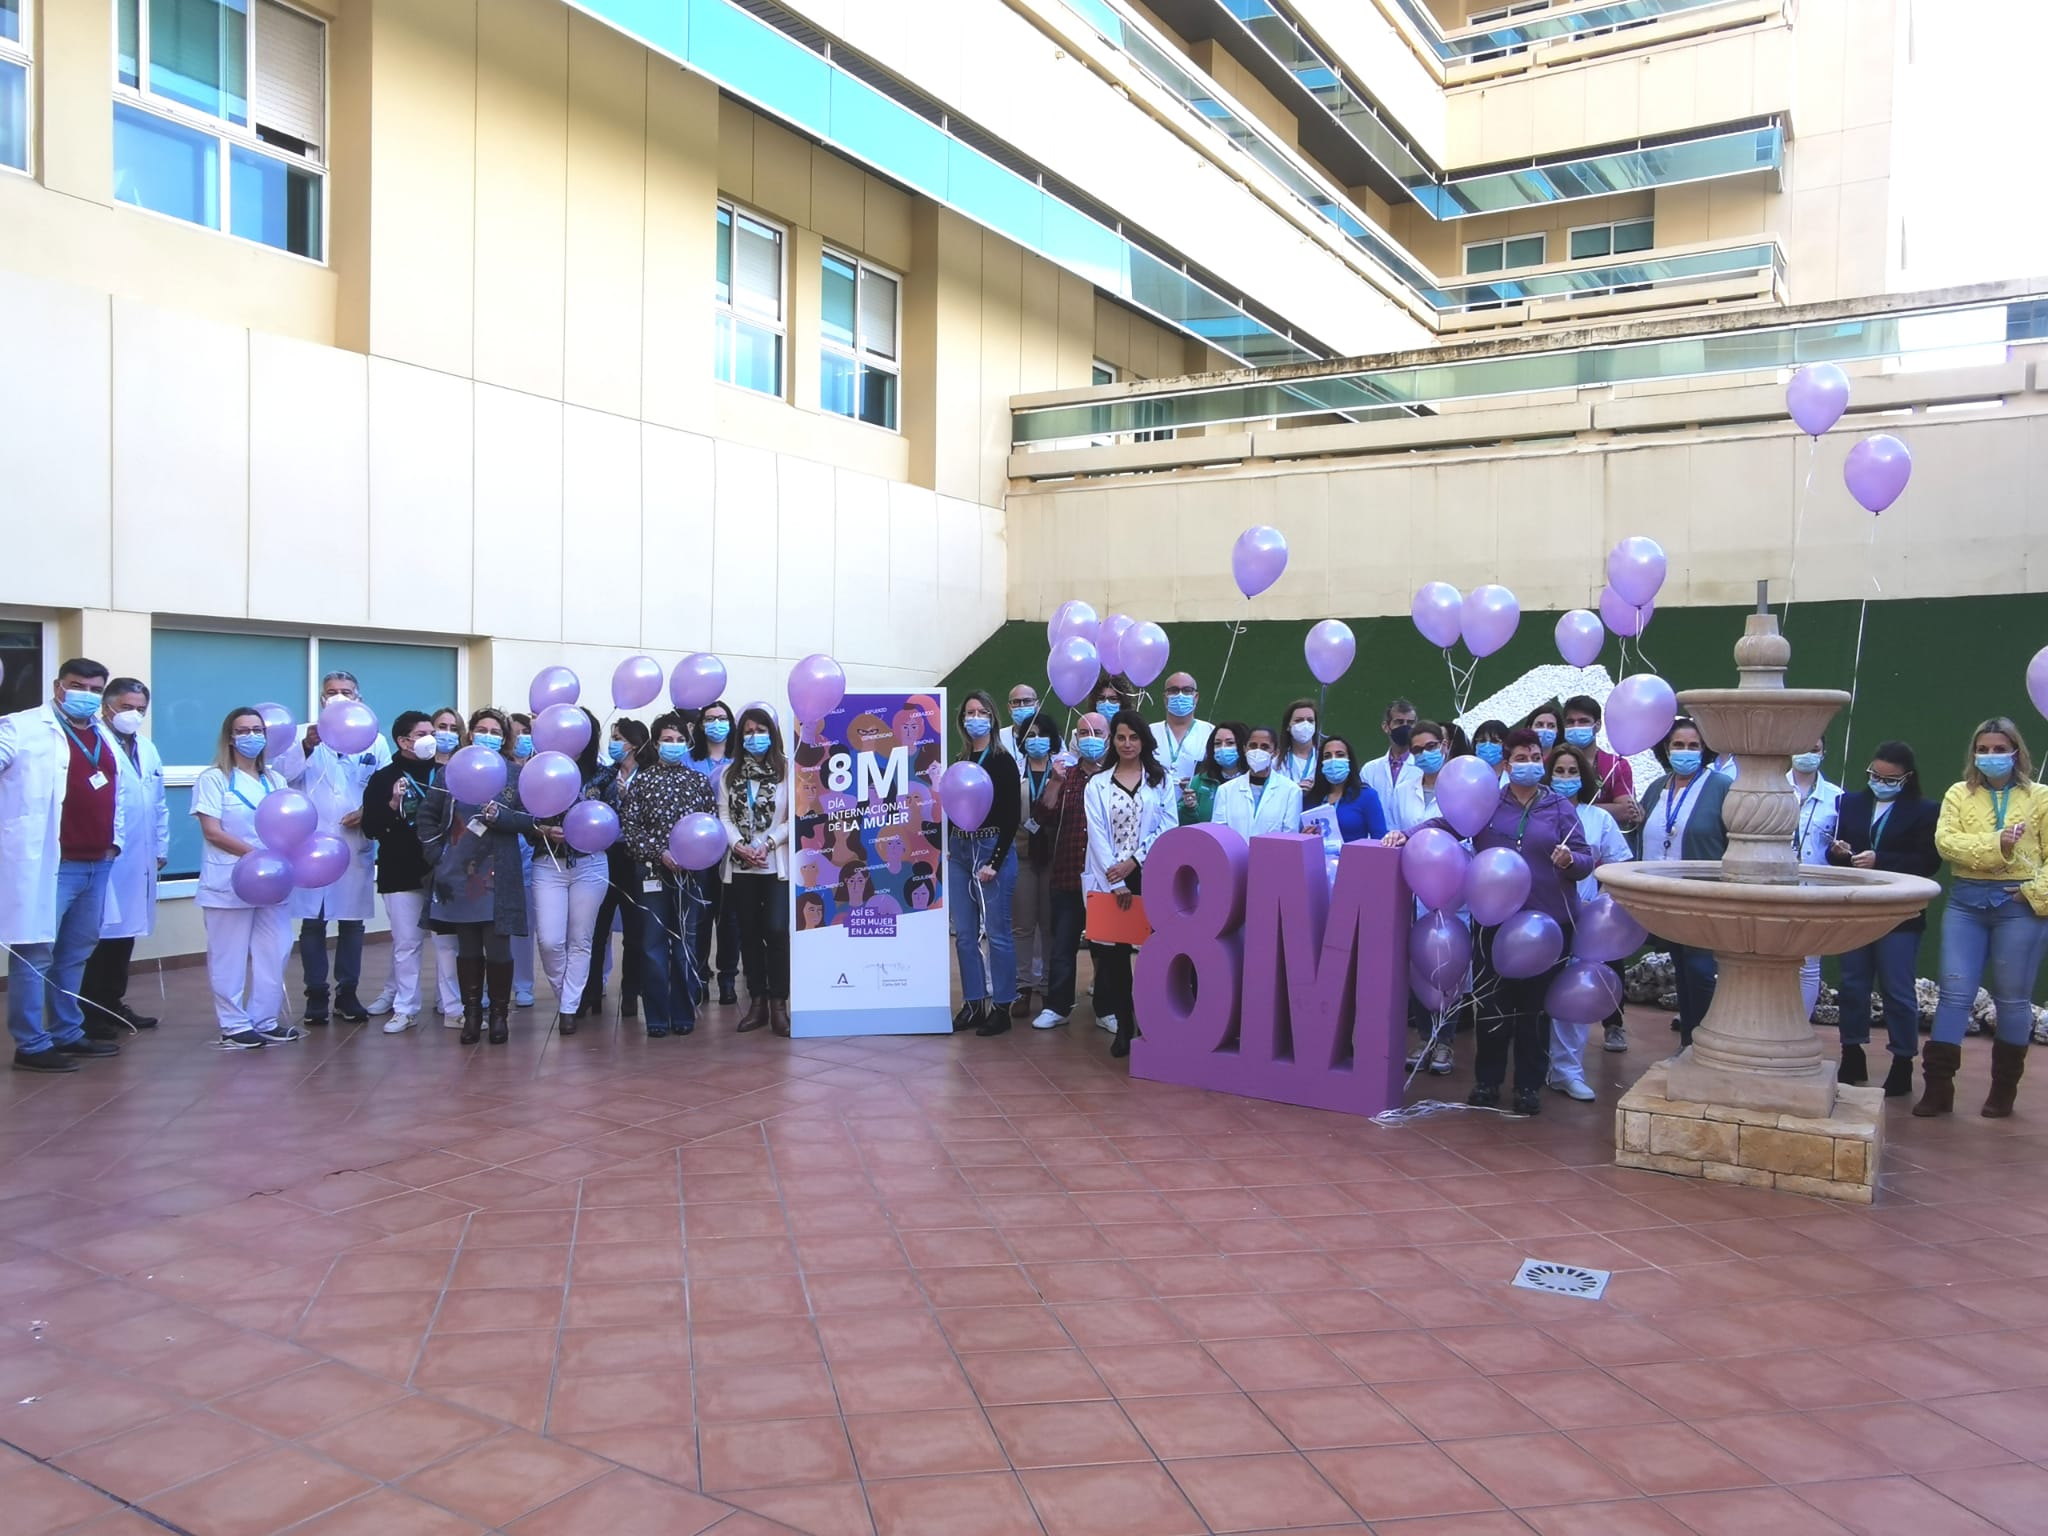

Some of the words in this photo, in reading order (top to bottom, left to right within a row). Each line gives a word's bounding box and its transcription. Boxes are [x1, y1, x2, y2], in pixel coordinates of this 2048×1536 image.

[828, 746, 909, 802] 8M
[828, 797, 845, 809] DÍA
[828, 801, 909, 821] INTERNACIONAL
[828, 821, 841, 832] DE
[843, 821, 860, 832] LA
[863, 812, 909, 830] MUJER
[851, 907, 864, 916] ASÍ
[851, 918, 866, 926] SER
[867, 918, 893, 926] MUJER
[874, 927, 895, 935] ASCS
[1129, 822, 1413, 1118] 8M
